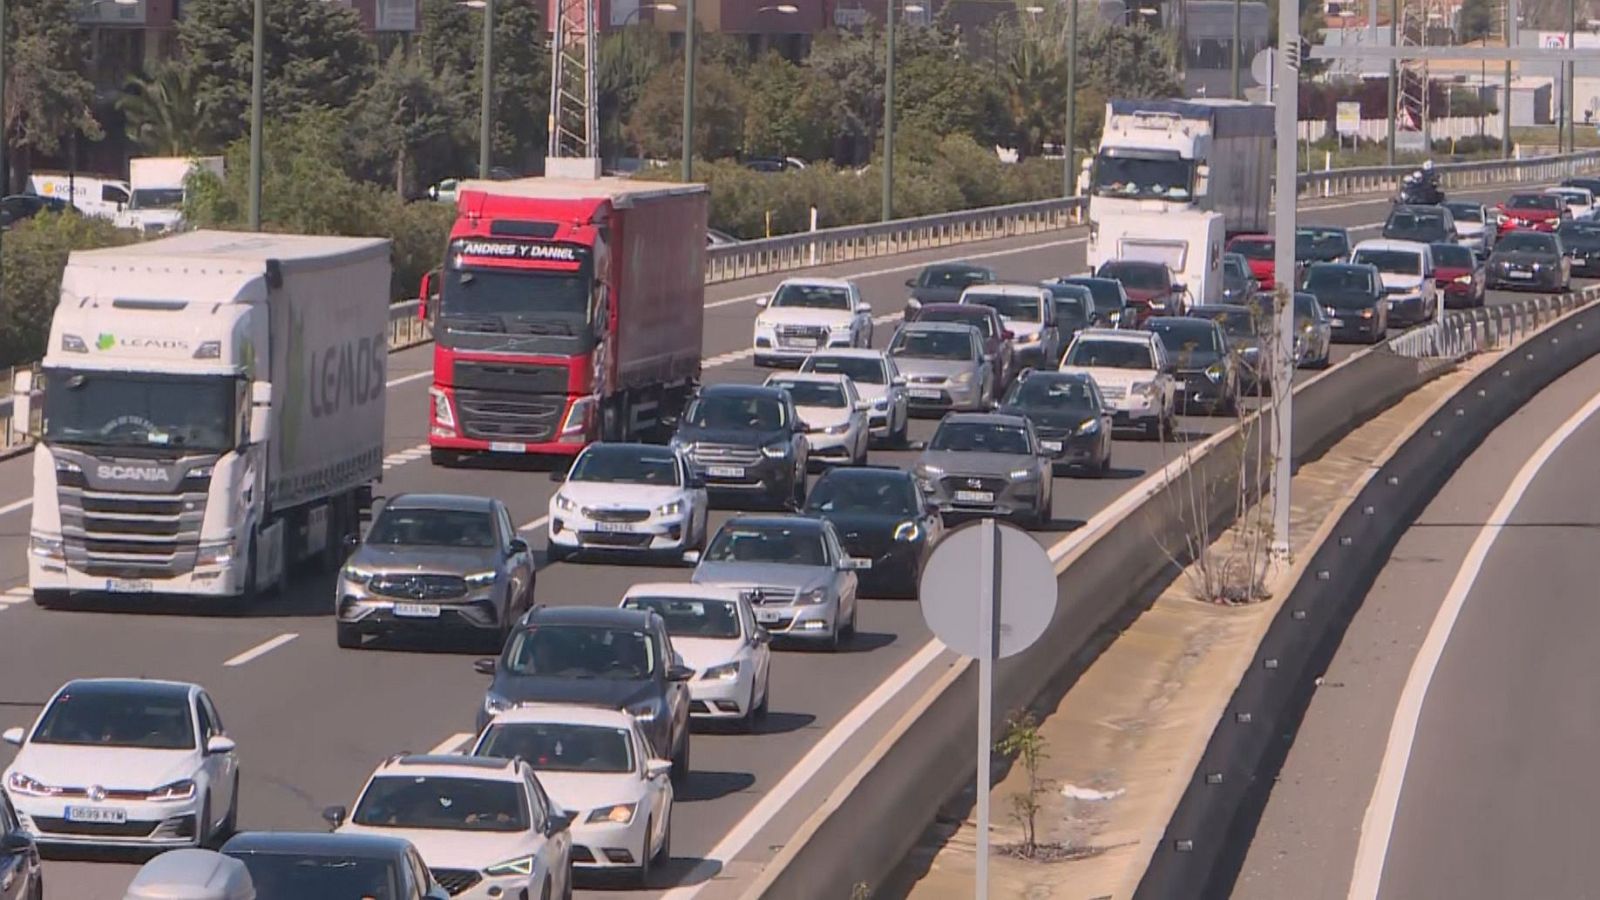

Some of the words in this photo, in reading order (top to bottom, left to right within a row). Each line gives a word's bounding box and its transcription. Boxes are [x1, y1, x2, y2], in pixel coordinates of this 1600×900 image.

[464, 243, 516, 256] ANDRES
[519, 245, 529, 257] Y
[531, 245, 575, 260] DANIEL
[121, 337, 189, 350] LEMOS
[310, 333, 384, 418] LEMOS
[97, 465, 169, 481] SCANIA
